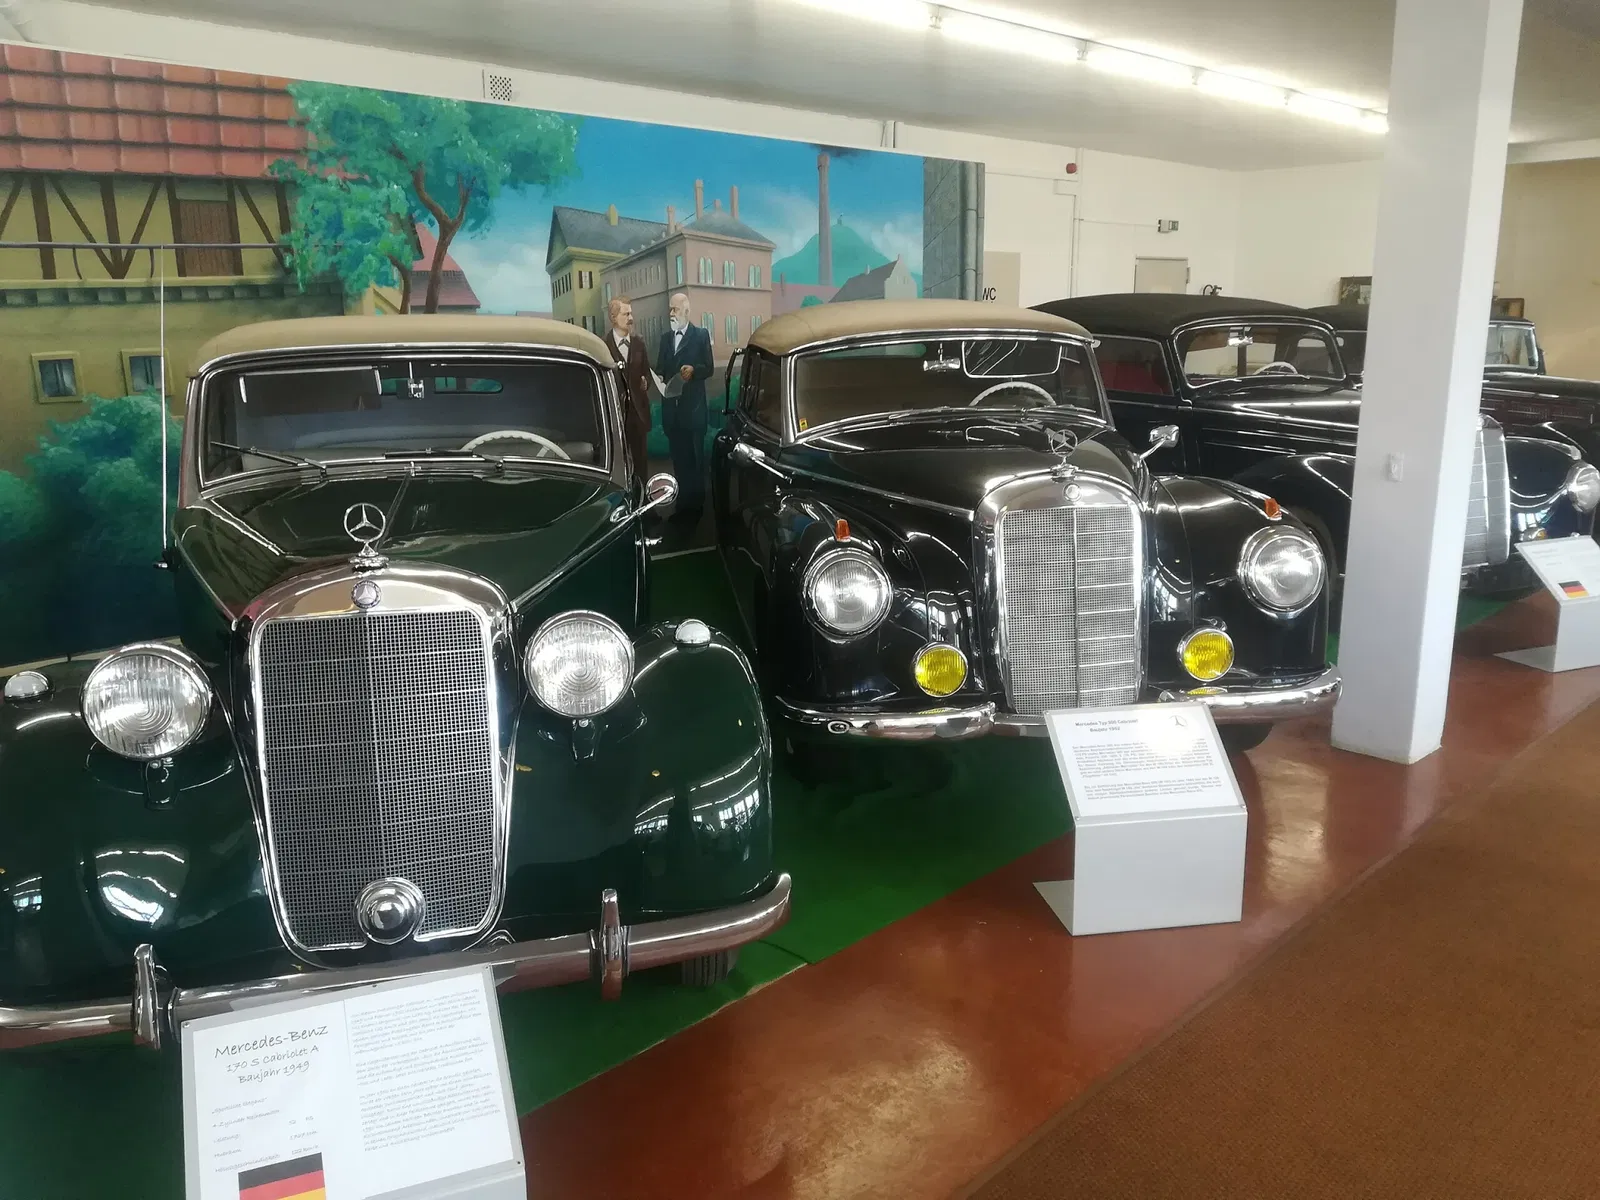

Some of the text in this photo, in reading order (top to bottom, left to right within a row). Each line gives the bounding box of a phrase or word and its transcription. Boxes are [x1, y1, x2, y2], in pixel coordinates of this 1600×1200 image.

[214, 1025, 329, 1058] Mercedes-Benz
[226, 1045, 320, 1073] 170 S Cabriolet A
[238, 1060, 310, 1084] Baujahr 1949
